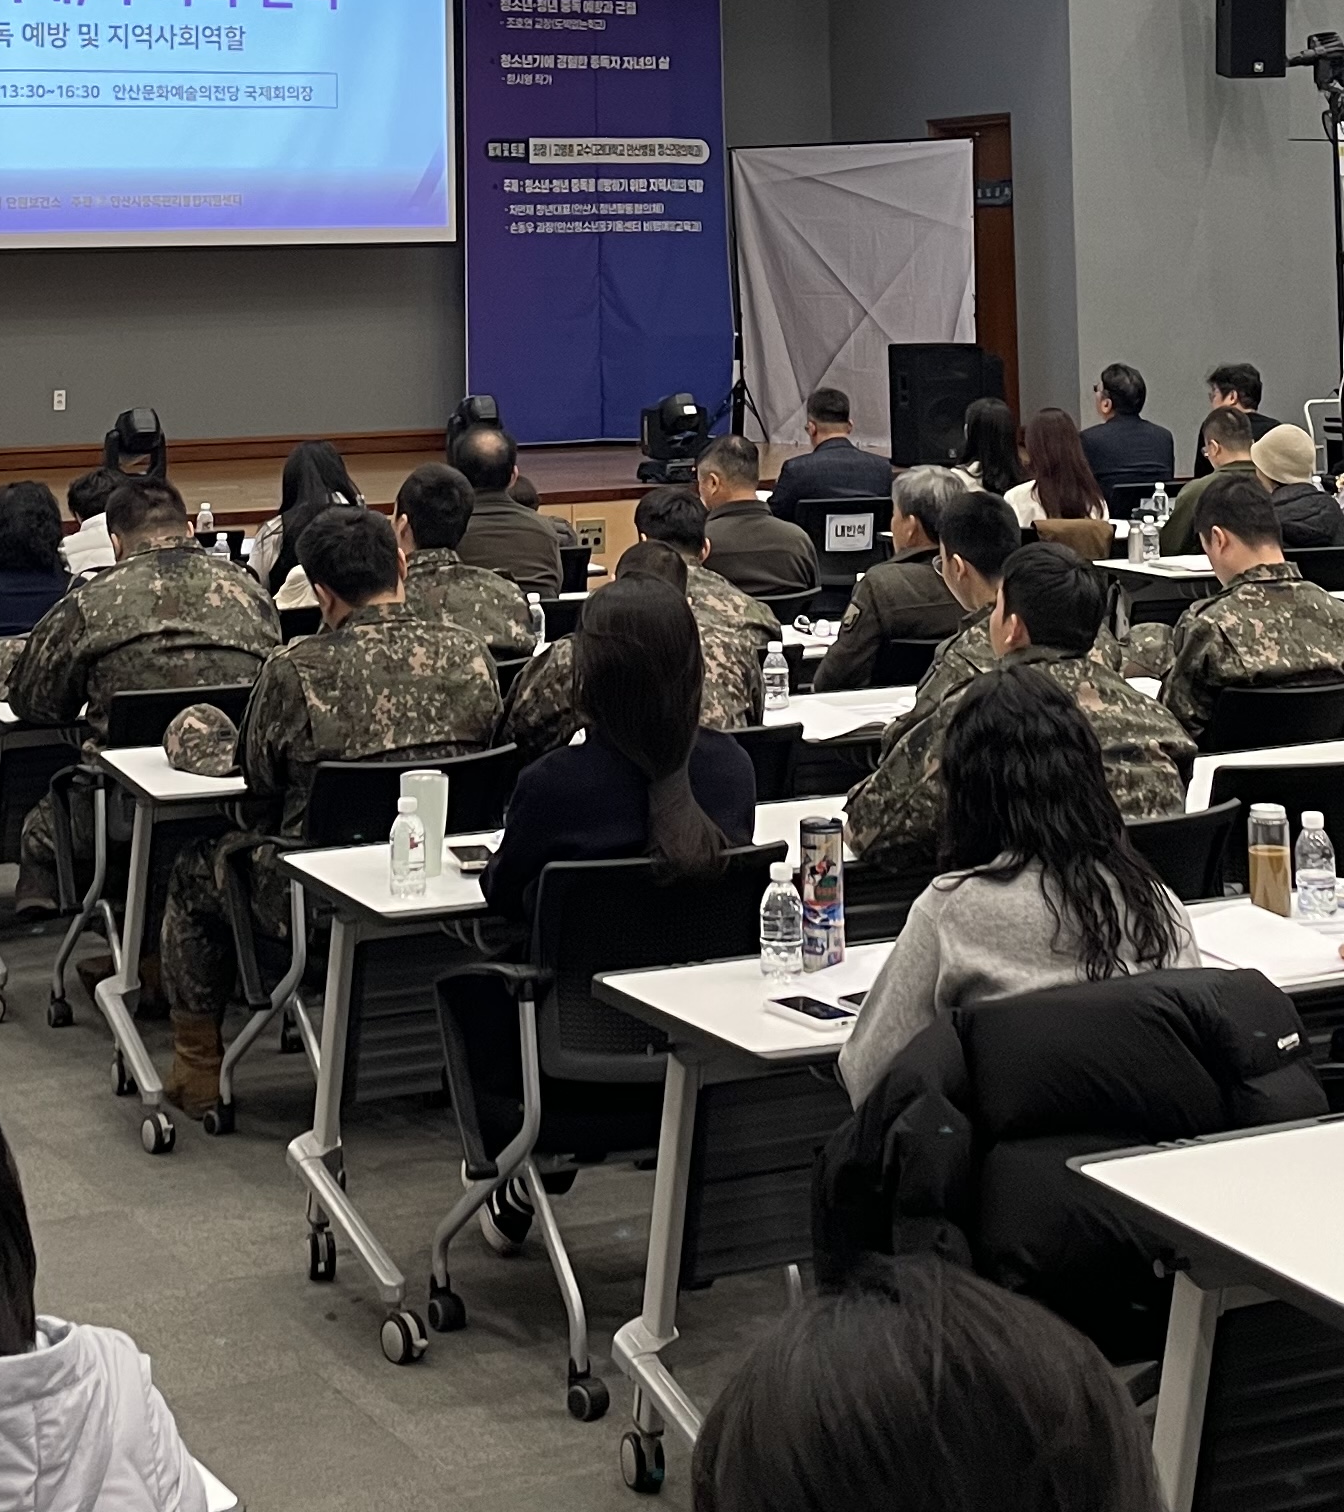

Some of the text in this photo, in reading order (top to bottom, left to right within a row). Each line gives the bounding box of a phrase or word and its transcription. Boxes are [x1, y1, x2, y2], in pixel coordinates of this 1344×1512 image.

[21, 22, 71, 50] 예방
[77, 24, 101, 50] 및
[107, 23, 247, 53] 지역사회역할
[0, 84, 101, 100] 13:30~16:30
[113, 83, 242, 103] 안산문화예술의전당
[244, 85, 315, 104] 국제회의장
